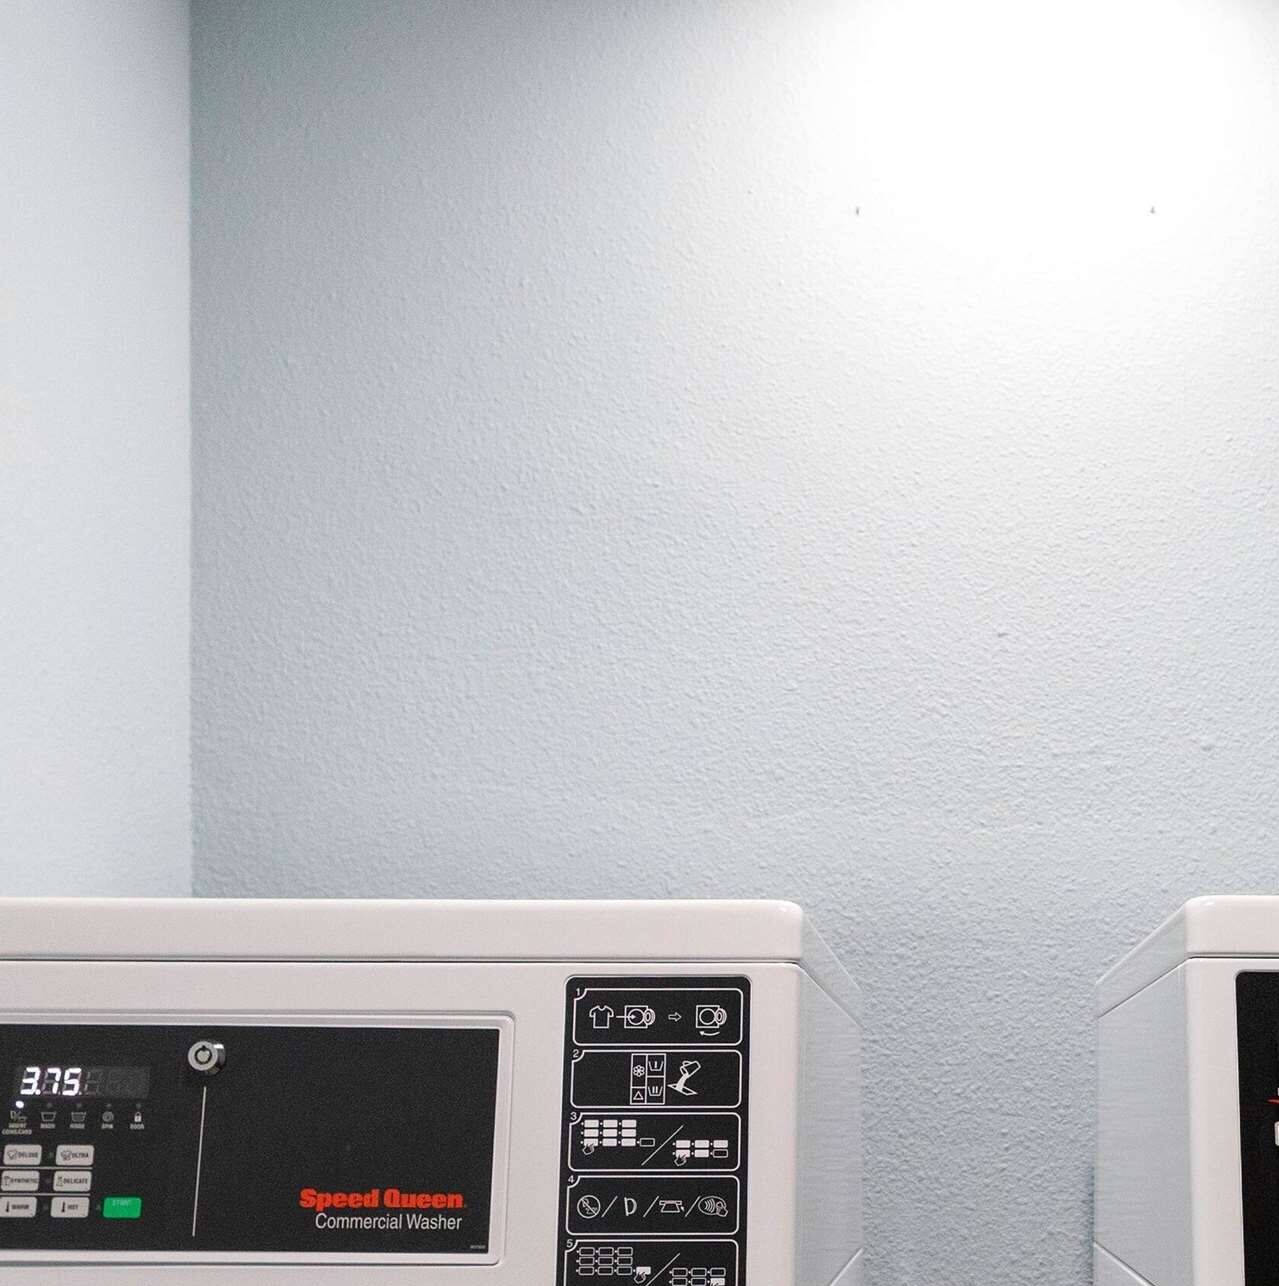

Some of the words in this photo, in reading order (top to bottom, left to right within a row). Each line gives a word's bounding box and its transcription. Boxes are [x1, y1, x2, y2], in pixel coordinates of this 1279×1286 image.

[576, 988, 582, 996] 1
[572, 1050, 578, 1058] 2
[570, 1112, 577, 1120] 3
[299, 1188, 380, 1212] Speed
[383, 1188, 464, 1208] Queen
[315, 1212, 403, 1229] Commercial
[407, 1214, 462, 1230] Washer
[566, 1240, 573, 1248] 5
